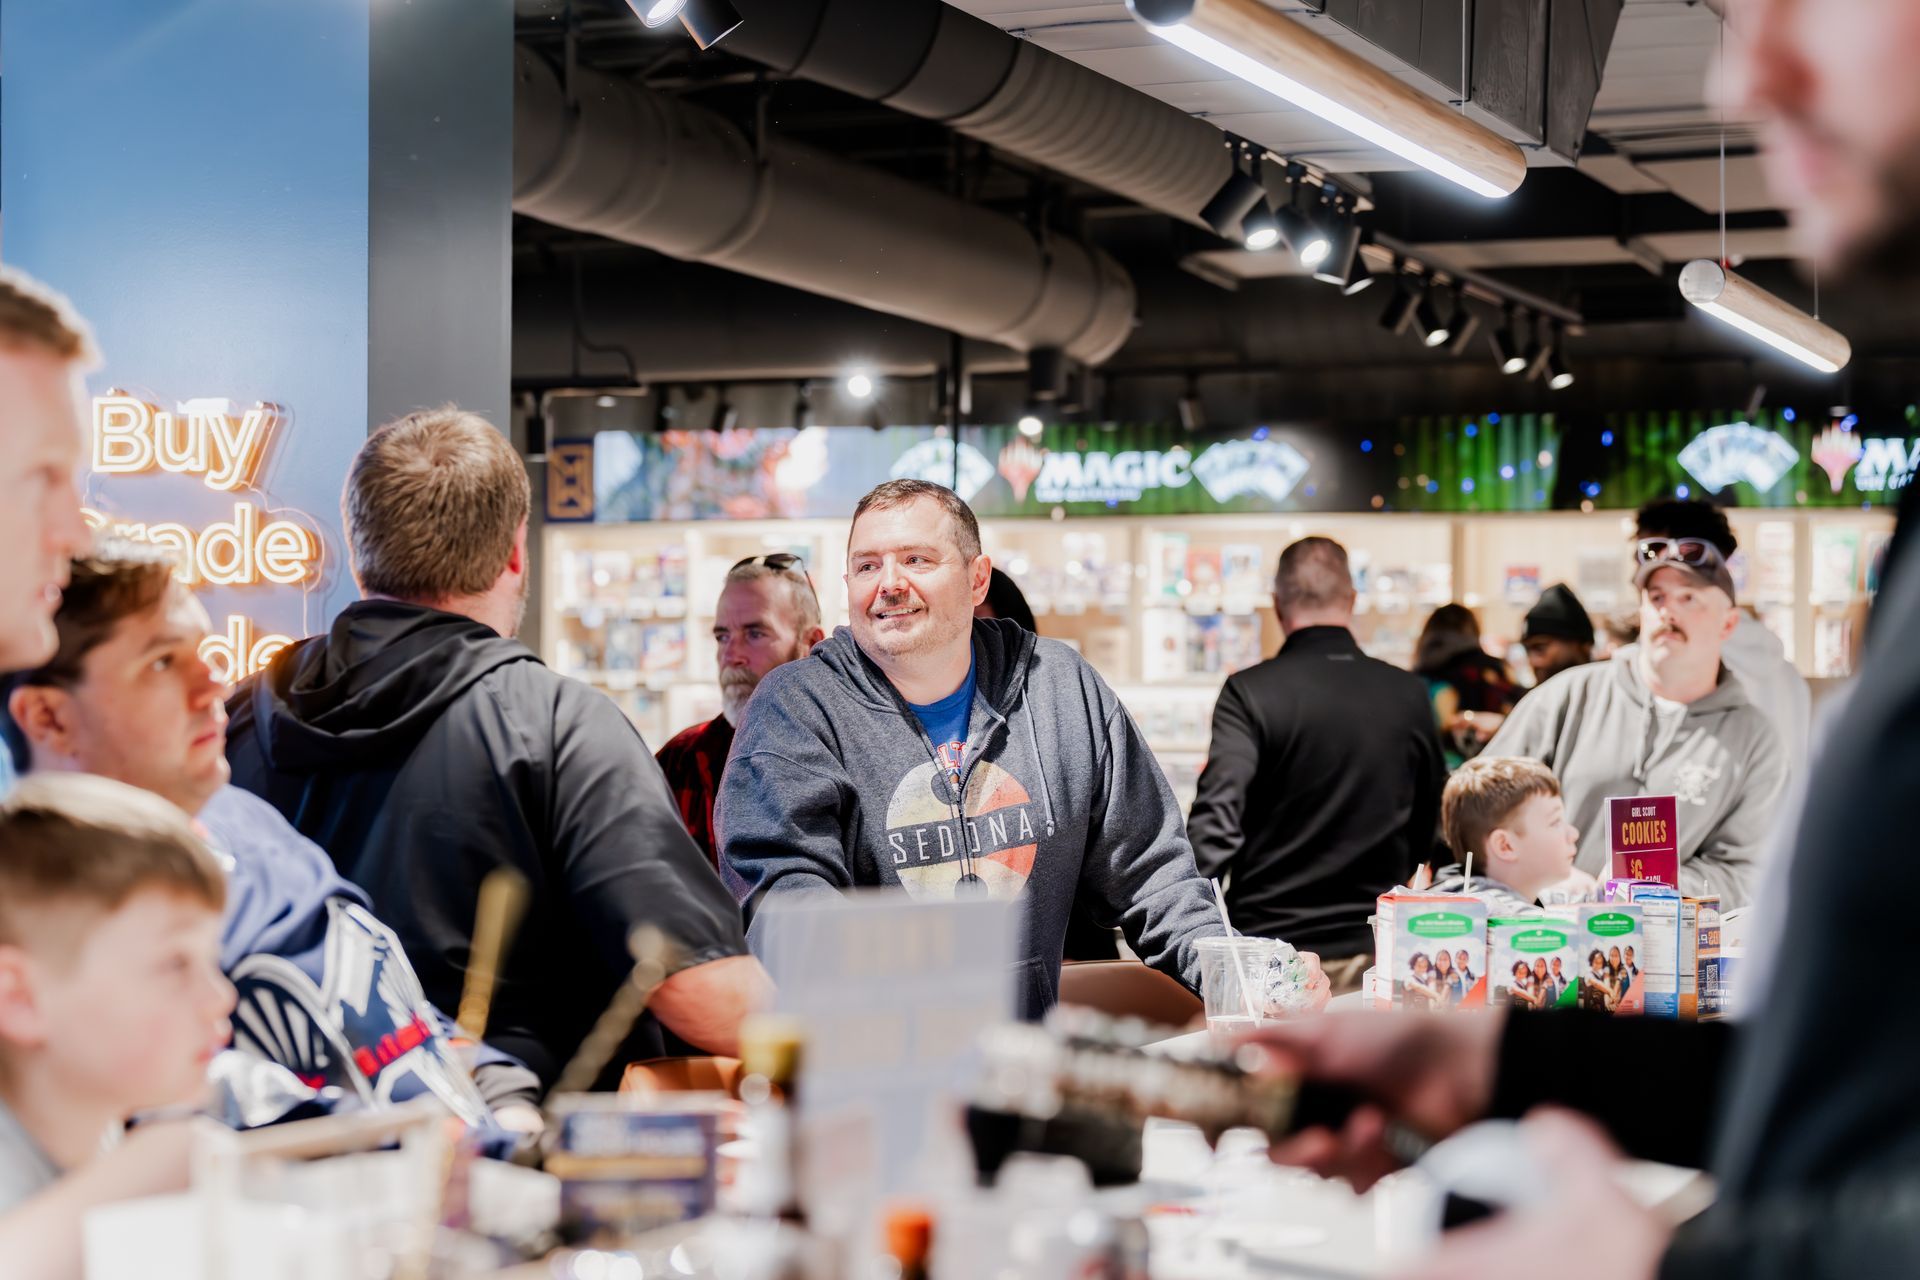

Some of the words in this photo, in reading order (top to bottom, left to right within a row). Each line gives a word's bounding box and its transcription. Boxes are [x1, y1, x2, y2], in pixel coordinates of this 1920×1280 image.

[91, 396, 263, 490] Buy
[1036, 450, 1193, 488] MAGIC
[80, 502, 309, 584] ade
[1631, 807, 1641, 817] GIRL
[1642, 806, 1656, 817] SCOUT
[1622, 820, 1667, 846] COOKIES
